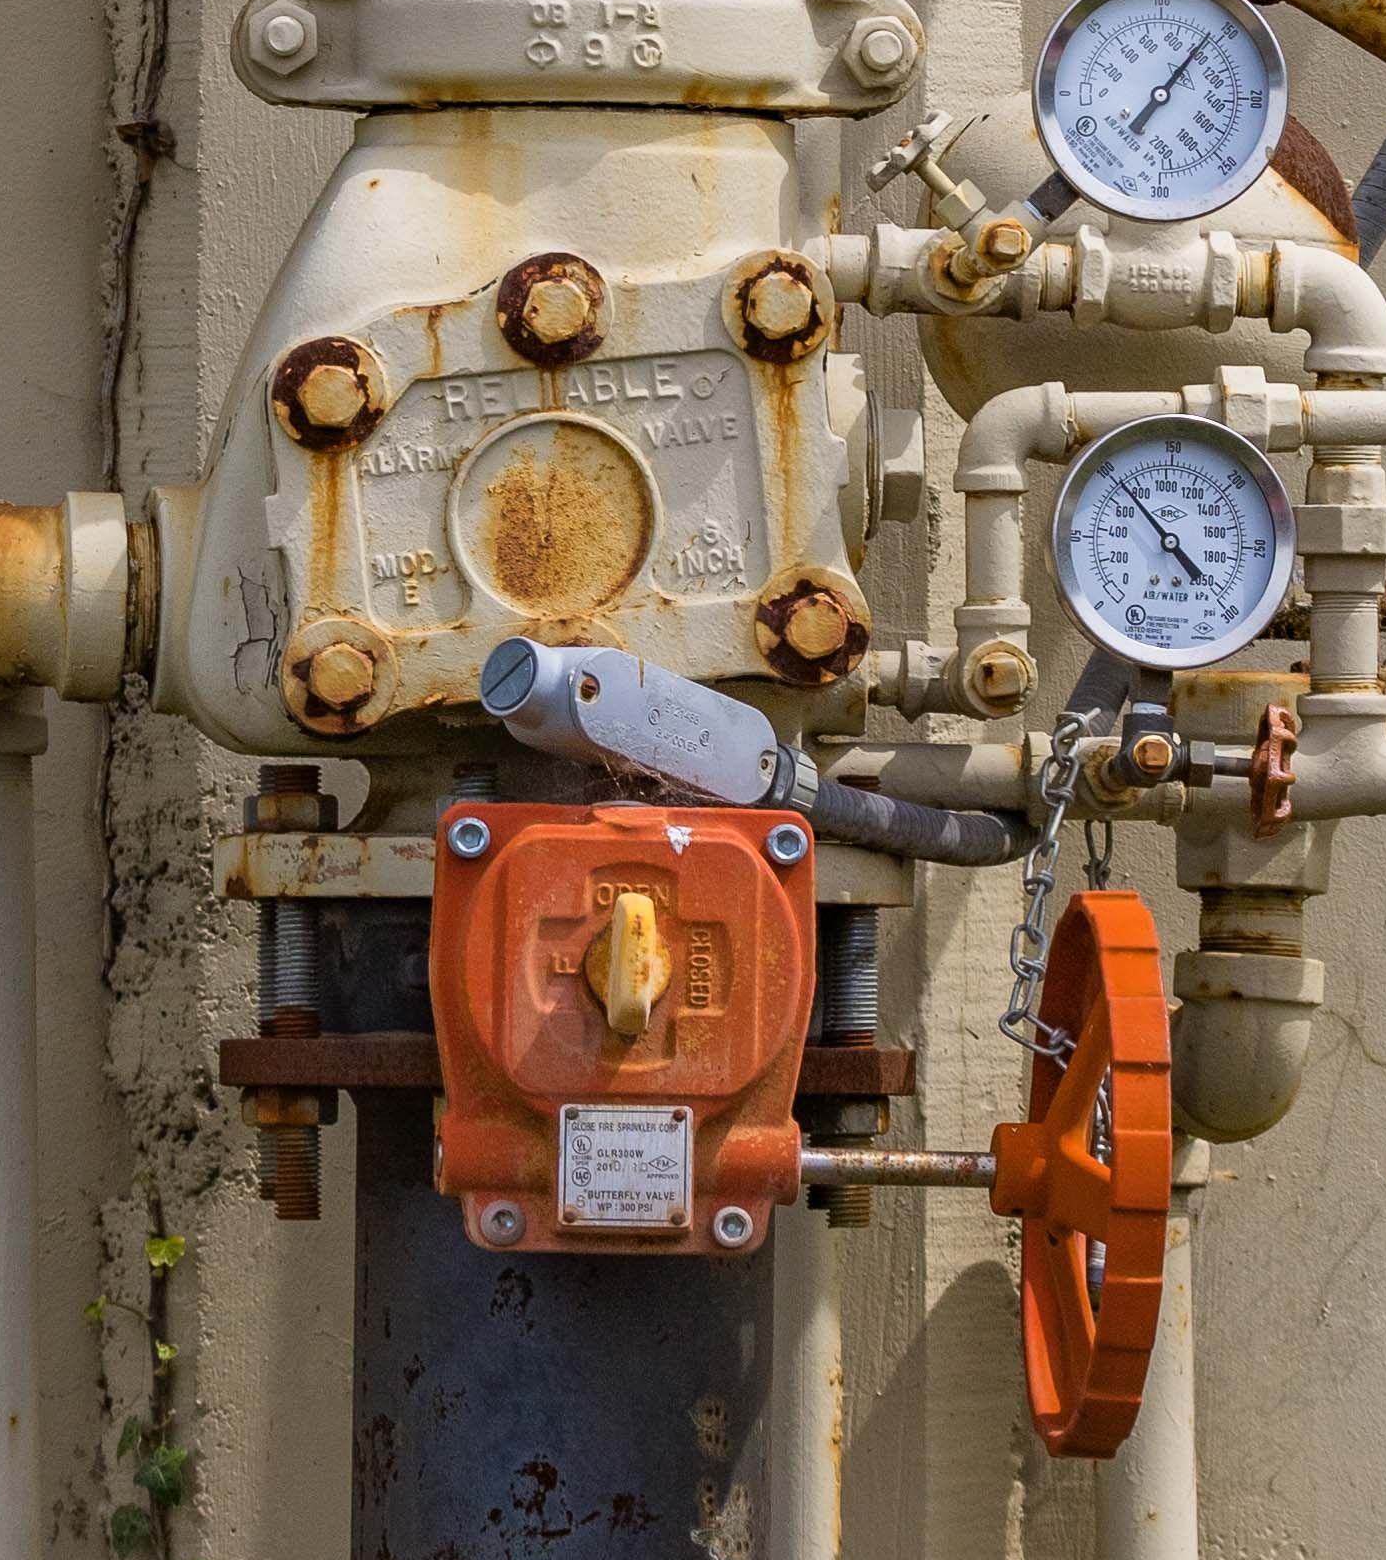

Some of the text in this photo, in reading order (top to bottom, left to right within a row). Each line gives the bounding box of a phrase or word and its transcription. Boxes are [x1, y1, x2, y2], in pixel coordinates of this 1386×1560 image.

[1086, 19, 1102, 35] 50
[1220, 21, 1239, 41] 150
[1138, 33, 1158, 54] 600
[1163, 32, 1183, 52] 800
[1120, 44, 1140, 64] 400
[1103, 63, 1123, 83] 200
[1201, 66, 1225, 90] 1200
[1099, 88, 1108, 97] 0
[1250, 90, 1262, 109] 200
[1203, 89, 1226, 113] 1400
[1192, 110, 1214, 134] 1600
[1104, 115, 1141, 153] AIR/WATER
[1175, 128, 1198, 151] 1800
[1148, 135, 1174, 160] 2050
[1142, 152, 1157, 167] kPa
[1217, 157, 1237, 176] 250
[1137, 171, 1151, 184] psi
[1150, 186, 1169, 199] 300
[640, 416, 739, 449] VALVE
[1165, 441, 1181, 454] 150
[1097, 461, 1115, 479] 100
[1155, 480, 1178, 493] 1000
[1227, 469, 1246, 490] 200
[1181, 487, 1204, 500] 1200
[1115, 505, 1135, 518] 600
[1160, 509, 1180, 518] BRC
[1197, 504, 1220, 517] 1400
[1070, 530, 1082, 542] 50
[1109, 527, 1128, 539] 400
[1203, 526, 1226, 539] 1600
[1254, 539, 1266, 559] 250
[676, 550, 745, 578] INCH
[1110, 551, 1128, 564] 200
[1204, 551, 1226, 563] 1800
[1122, 573, 1129, 585] 0
[403, 581, 420, 606] E
[1143, 591, 1189, 603] AIR/WATER
[1195, 591, 1209, 602] kPa
[1094, 601, 1104, 610] 0
[1204, 609, 1216, 619] psi
[1220, 604, 1240, 624] 300
[689, 928, 711, 1008] CLOSED
[571, 1122, 595, 1132] GLOBE
[598, 1122, 613, 1132] FIRE
[618, 1122, 657, 1132] SPRINKLER
[597, 1149, 644, 1158] GLR300W
[646, 1192, 675, 1200] VALVE
[620, 1203, 635, 1212] 300
[638, 1204, 653, 1212] PSI
